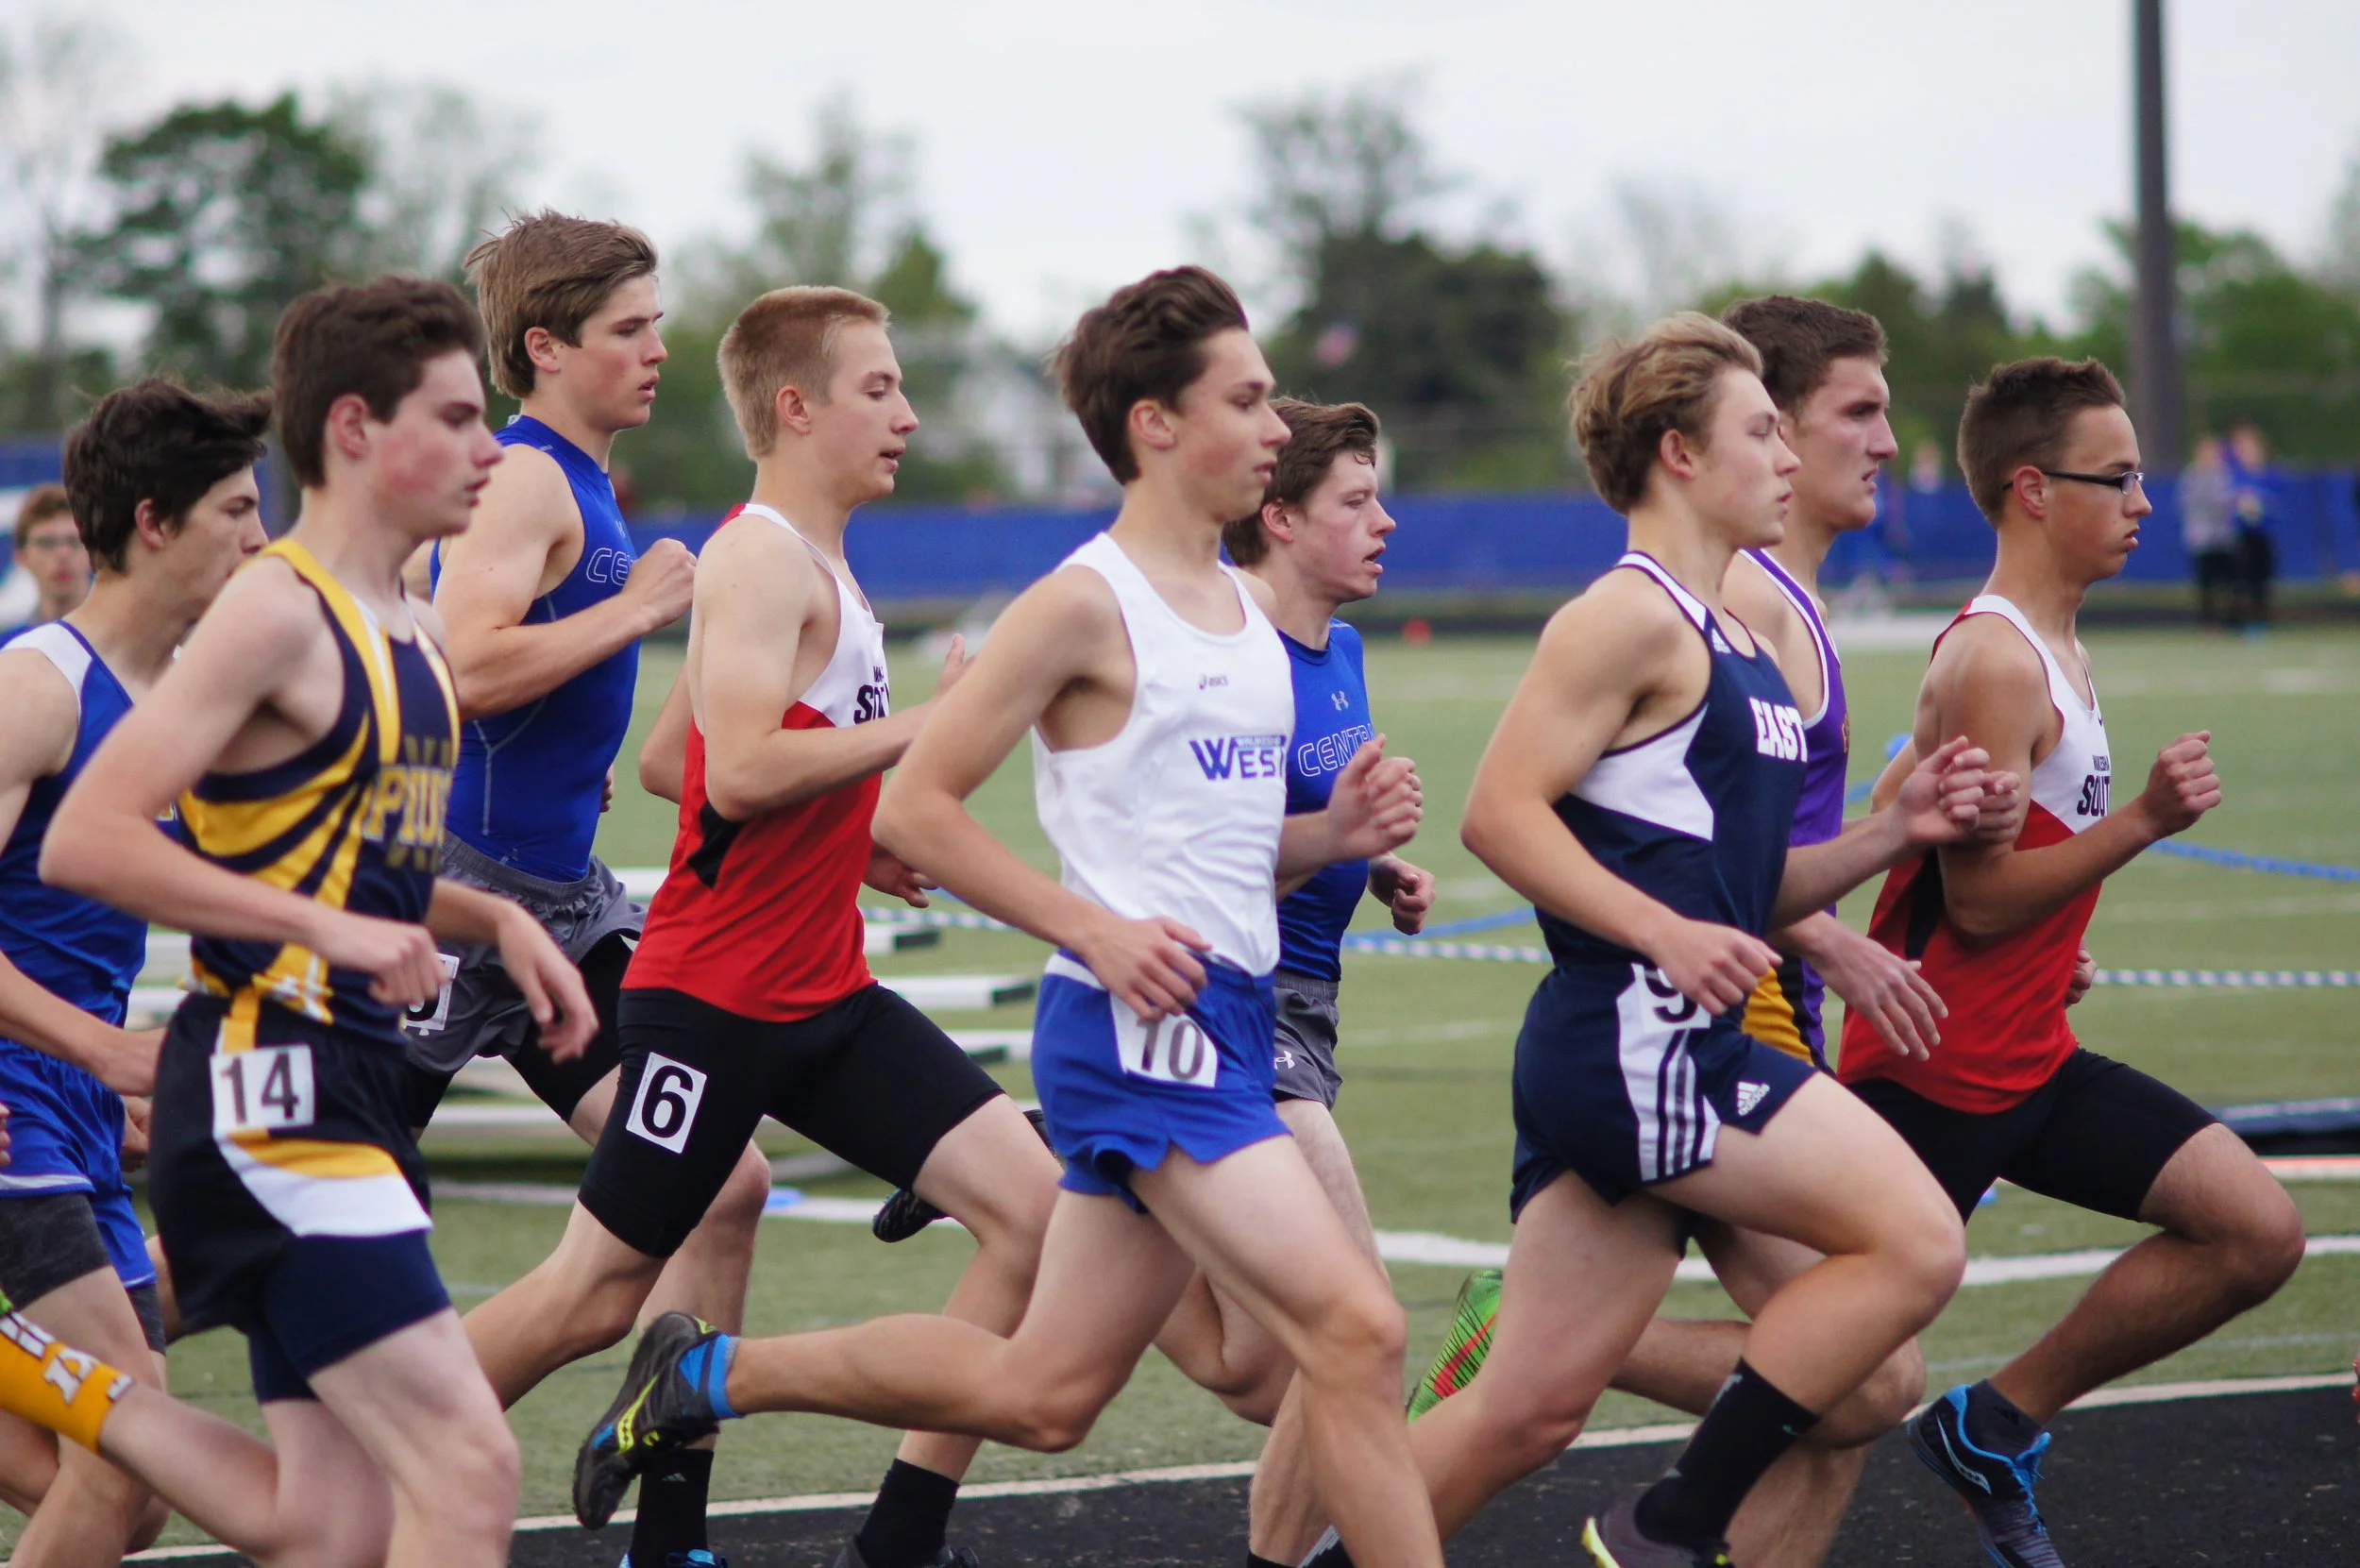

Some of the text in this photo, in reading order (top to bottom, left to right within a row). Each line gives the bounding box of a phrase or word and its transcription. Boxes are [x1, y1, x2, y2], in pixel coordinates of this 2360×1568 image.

[1748, 696, 1809, 763] EAST
[1136, 1018, 1205, 1081] 10
[218, 1050, 301, 1124] 14
[641, 1064, 694, 1139] 6
